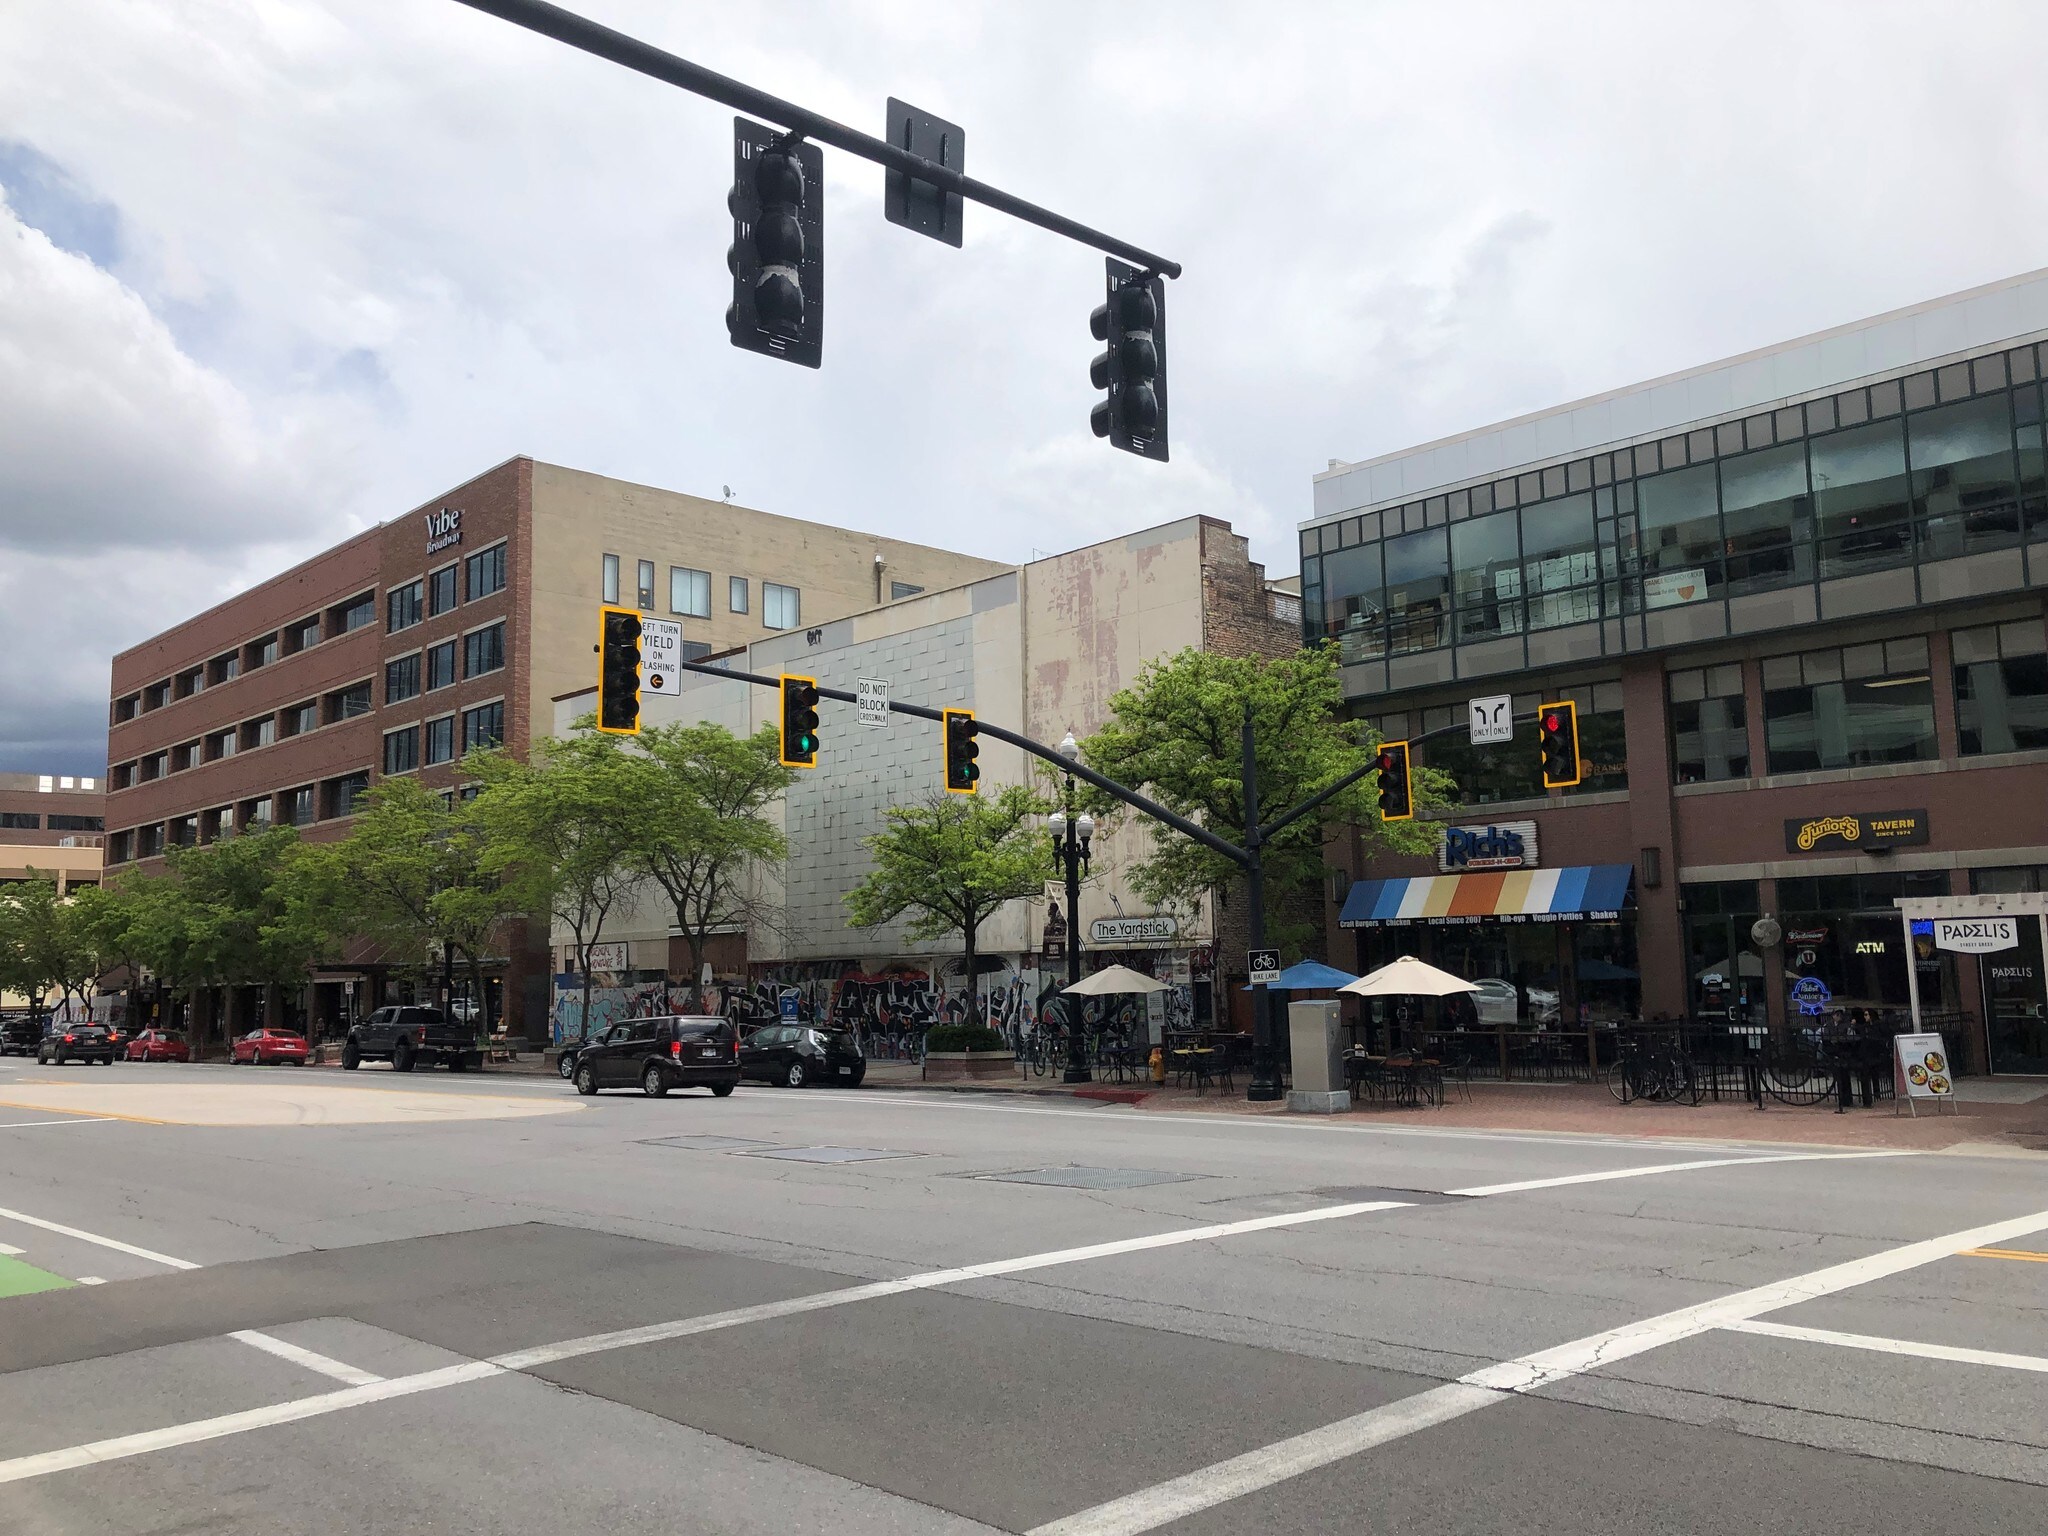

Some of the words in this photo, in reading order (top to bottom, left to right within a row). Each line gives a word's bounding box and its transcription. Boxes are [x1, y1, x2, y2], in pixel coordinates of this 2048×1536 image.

[424, 508, 460, 538] Vibe
[426, 533, 461, 554] Broadway
[642, 622, 656, 631] EFT
[660, 624, 679, 634] TURN
[643, 634, 673, 649] YIELD
[652, 651, 663, 660] ON
[859, 682, 870, 694] DO
[872, 684, 887, 696] NOT
[859, 698, 886, 712] BLOCK
[1473, 729, 1490, 738] ONLY
[1493, 726, 1510, 735] ONLY
[1798, 817, 1860, 850] Junior's
[1871, 819, 1915, 831] TAVERN
[1446, 826, 1525, 867] Rich's
[1355, 919, 1379, 928] Burgers
[1385, 919, 1411, 927] Chicken
[1428, 917, 1445, 925] Local
[1446, 916, 1465, 925] Since
[1465, 915, 1482, 924] 2007
[1500, 914, 1526, 923] Rib-eye
[1532, 913, 1557, 922] Veggie
[1558, 912, 1584, 921] Patties
[1590, 910, 1618, 920] Shakes
[1097, 924, 1117, 936] The
[1119, 920, 1169, 936] Yardstick
[1855, 942, 1885, 954] ATM
